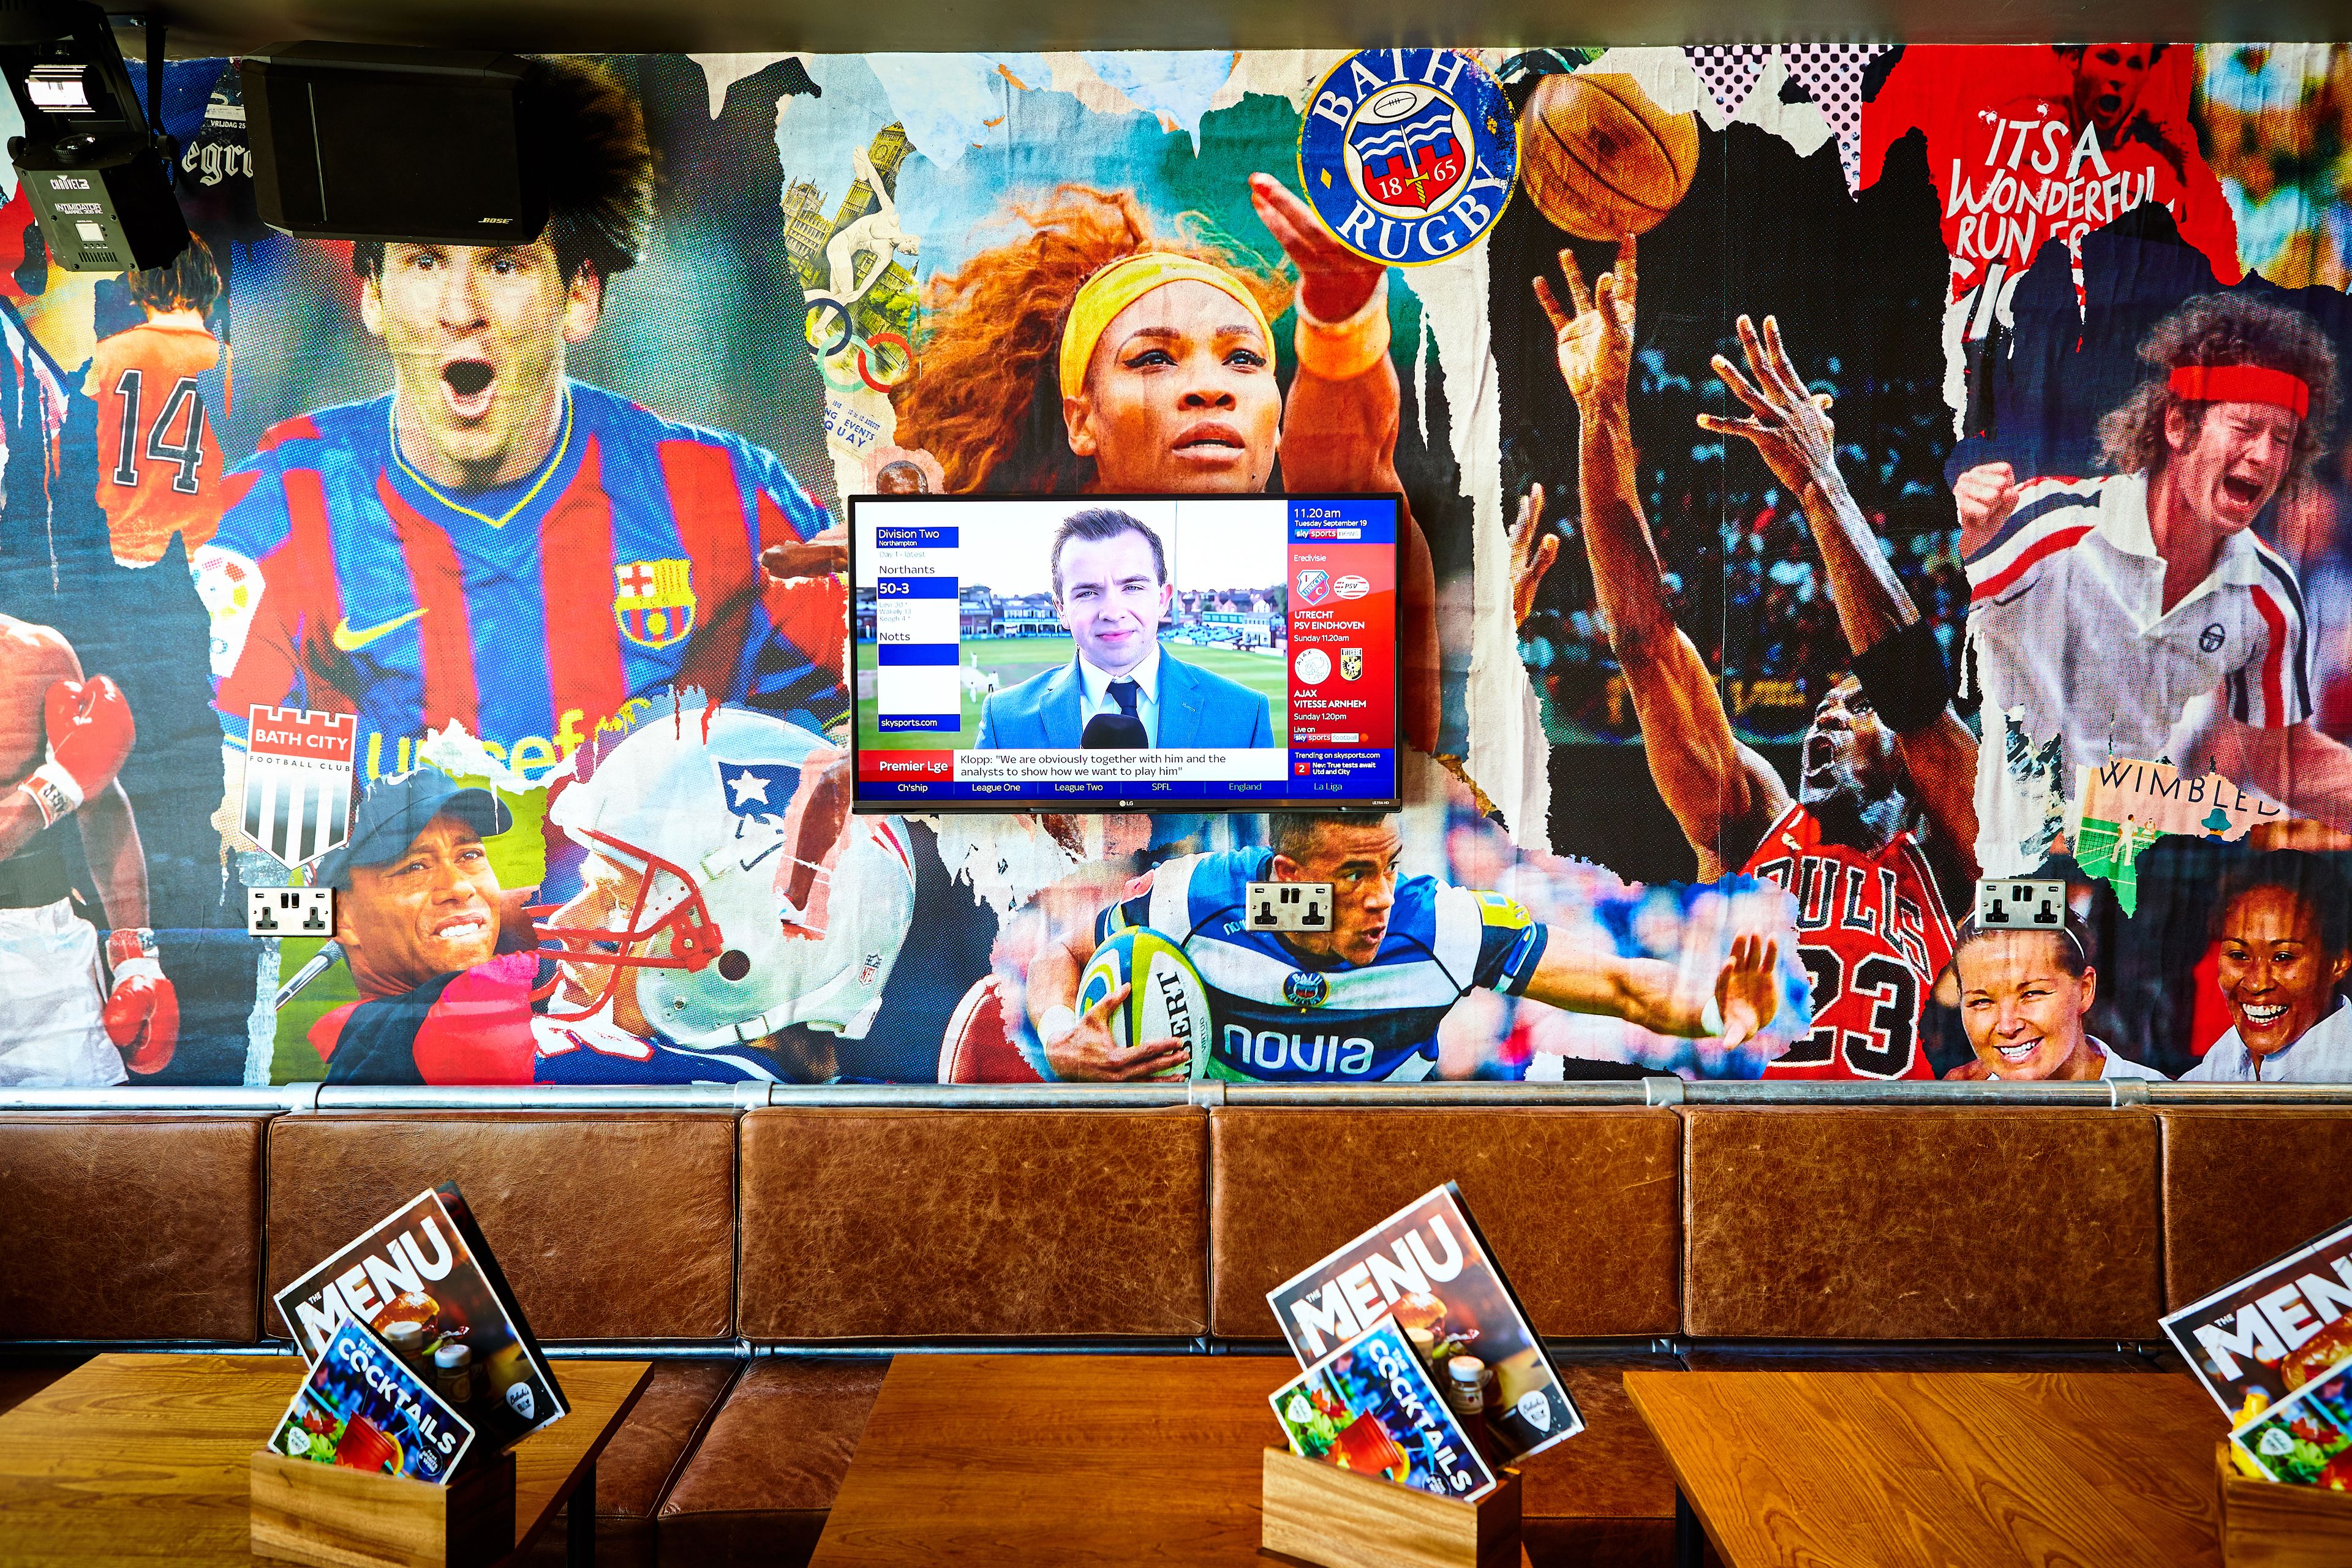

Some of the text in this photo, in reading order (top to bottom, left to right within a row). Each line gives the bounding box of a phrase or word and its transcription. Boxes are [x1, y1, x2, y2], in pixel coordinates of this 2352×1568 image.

[1313, 48, 1469, 130] BATH
[210, 119, 238, 128] VRIJDAG
[2065, 120, 2111, 180] A
[50, 179, 80, 189] CHAUVET
[1379, 160, 1457, 199] 18 65
[1336, 156, 1507, 259] RUGBY
[1956, 209, 2037, 265] RUN
[113, 369, 206, 494] 14
[844, 419, 875, 441] EVENTS
[1294, 508, 1323, 518] 11.20
[878, 529, 940, 538] Division Two
[1296, 530, 1309, 539] sky
[1311, 530, 1336, 538] sports
[880, 565, 935, 574] Northants
[880, 582, 910, 594] 50-3
[1294, 611, 1334, 619] UTRECHT
[1294, 689, 1317, 698] AJAX
[881, 719, 938, 728] skysports.com
[255, 728, 349, 751] BATH CITY
[960, 755, 992, 765] Klopp:
[996, 755, 1016, 764] "We
[1039, 755, 1088, 765] obviously
[1091, 755, 1136, 765] together
[1139, 755, 1161, 763] with
[1164, 755, 1183, 763] him
[1186, 755, 1205, 763] and
[1208, 755, 1226, 763] the
[1295, 752, 1323, 760] Trending
[1333, 752, 1380, 760] skysports.com
[250, 756, 350, 772] FOOTBALL CLUB
[880, 761, 948, 774] Premier Lge
[961, 767, 1004, 777] analysts
[1021, 767, 1048, 776] show
[1050, 767, 1072, 776] how
[1135, 767, 1155, 777] play
[1159, 767, 1182, 775] him"
[897, 783, 928, 793] Ch'ship
[972, 783, 1002, 793] League
[1055, 783, 1084, 793] League
[1229, 783, 1262, 793] England
[1326, 783, 1342, 791] Liga
[1768, 944, 1921, 1080] 23
[1224, 1023, 1374, 1075] novia
[295, 1215, 453, 1345] MENU
[1290, 1213, 1464, 1358] MENU
[308, 1291, 322, 1304] THE
[1306, 1289, 1321, 1303] THE
[2193, 1253, 2352, 1382] MEN
[2214, 1313, 2234, 1327] THE
[358, 1338, 376, 1359] THE
[338, 1337, 457, 1455] COCKTAILS
[1370, 1340, 1473, 1491] COCKTAILS
